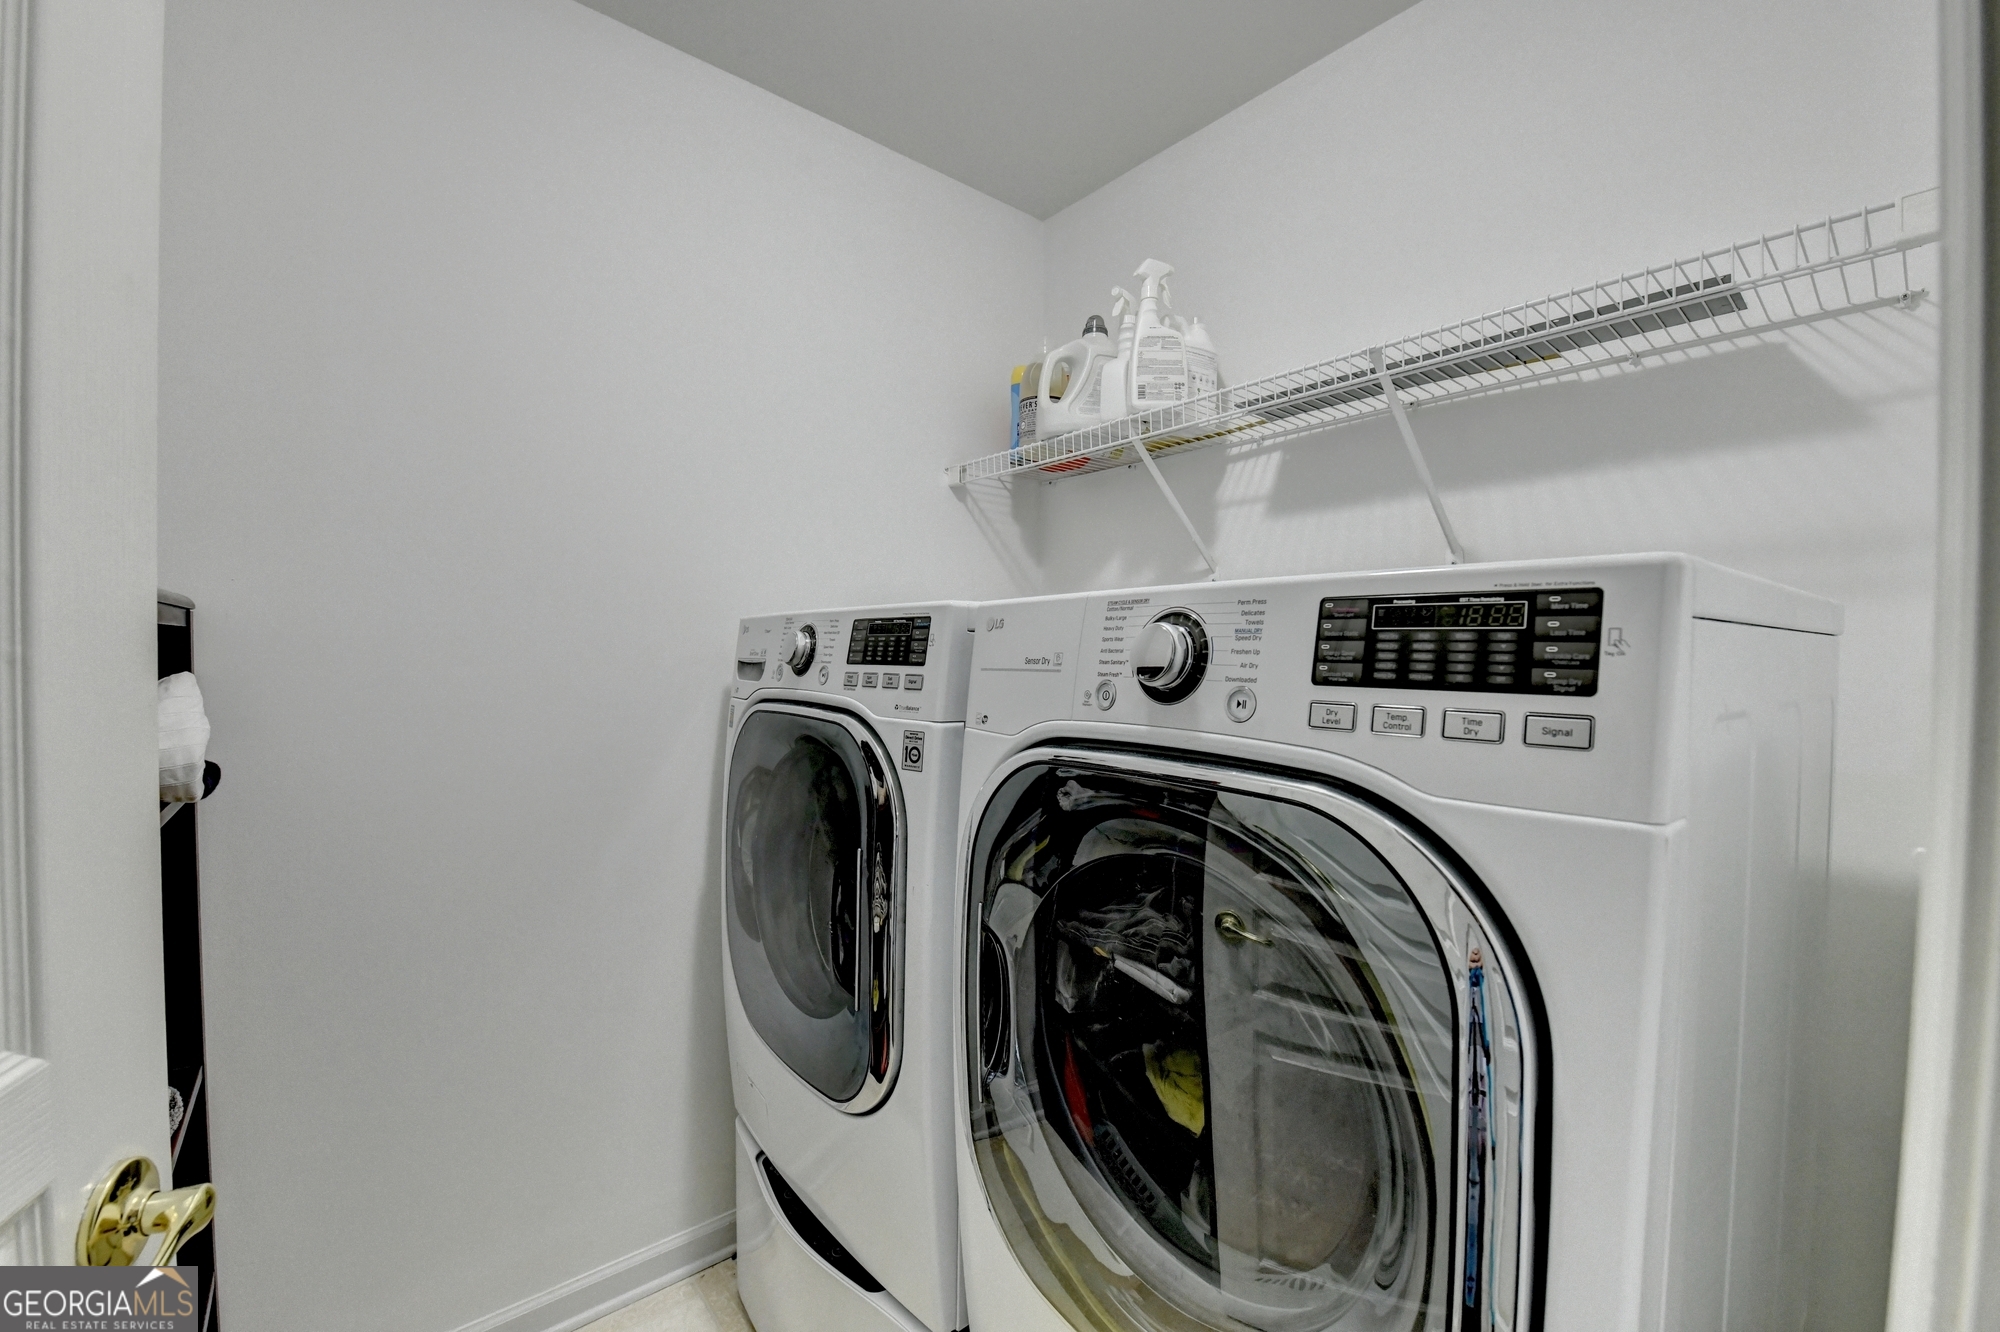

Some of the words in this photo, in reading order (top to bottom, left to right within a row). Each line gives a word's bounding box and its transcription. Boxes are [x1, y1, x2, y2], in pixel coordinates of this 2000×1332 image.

[1041, 657, 1050, 666] Dry
[1326, 709, 1338, 718] Dry
[1386, 712, 1408, 722] Temp.
[1322, 717, 1341, 726] Level
[1462, 718, 1483, 726] Time
[1383, 722, 1412, 731] Control
[1463, 728, 1479, 737] Dry
[1542, 727, 1573, 738] Signal
[905, 746, 921, 764] 10
